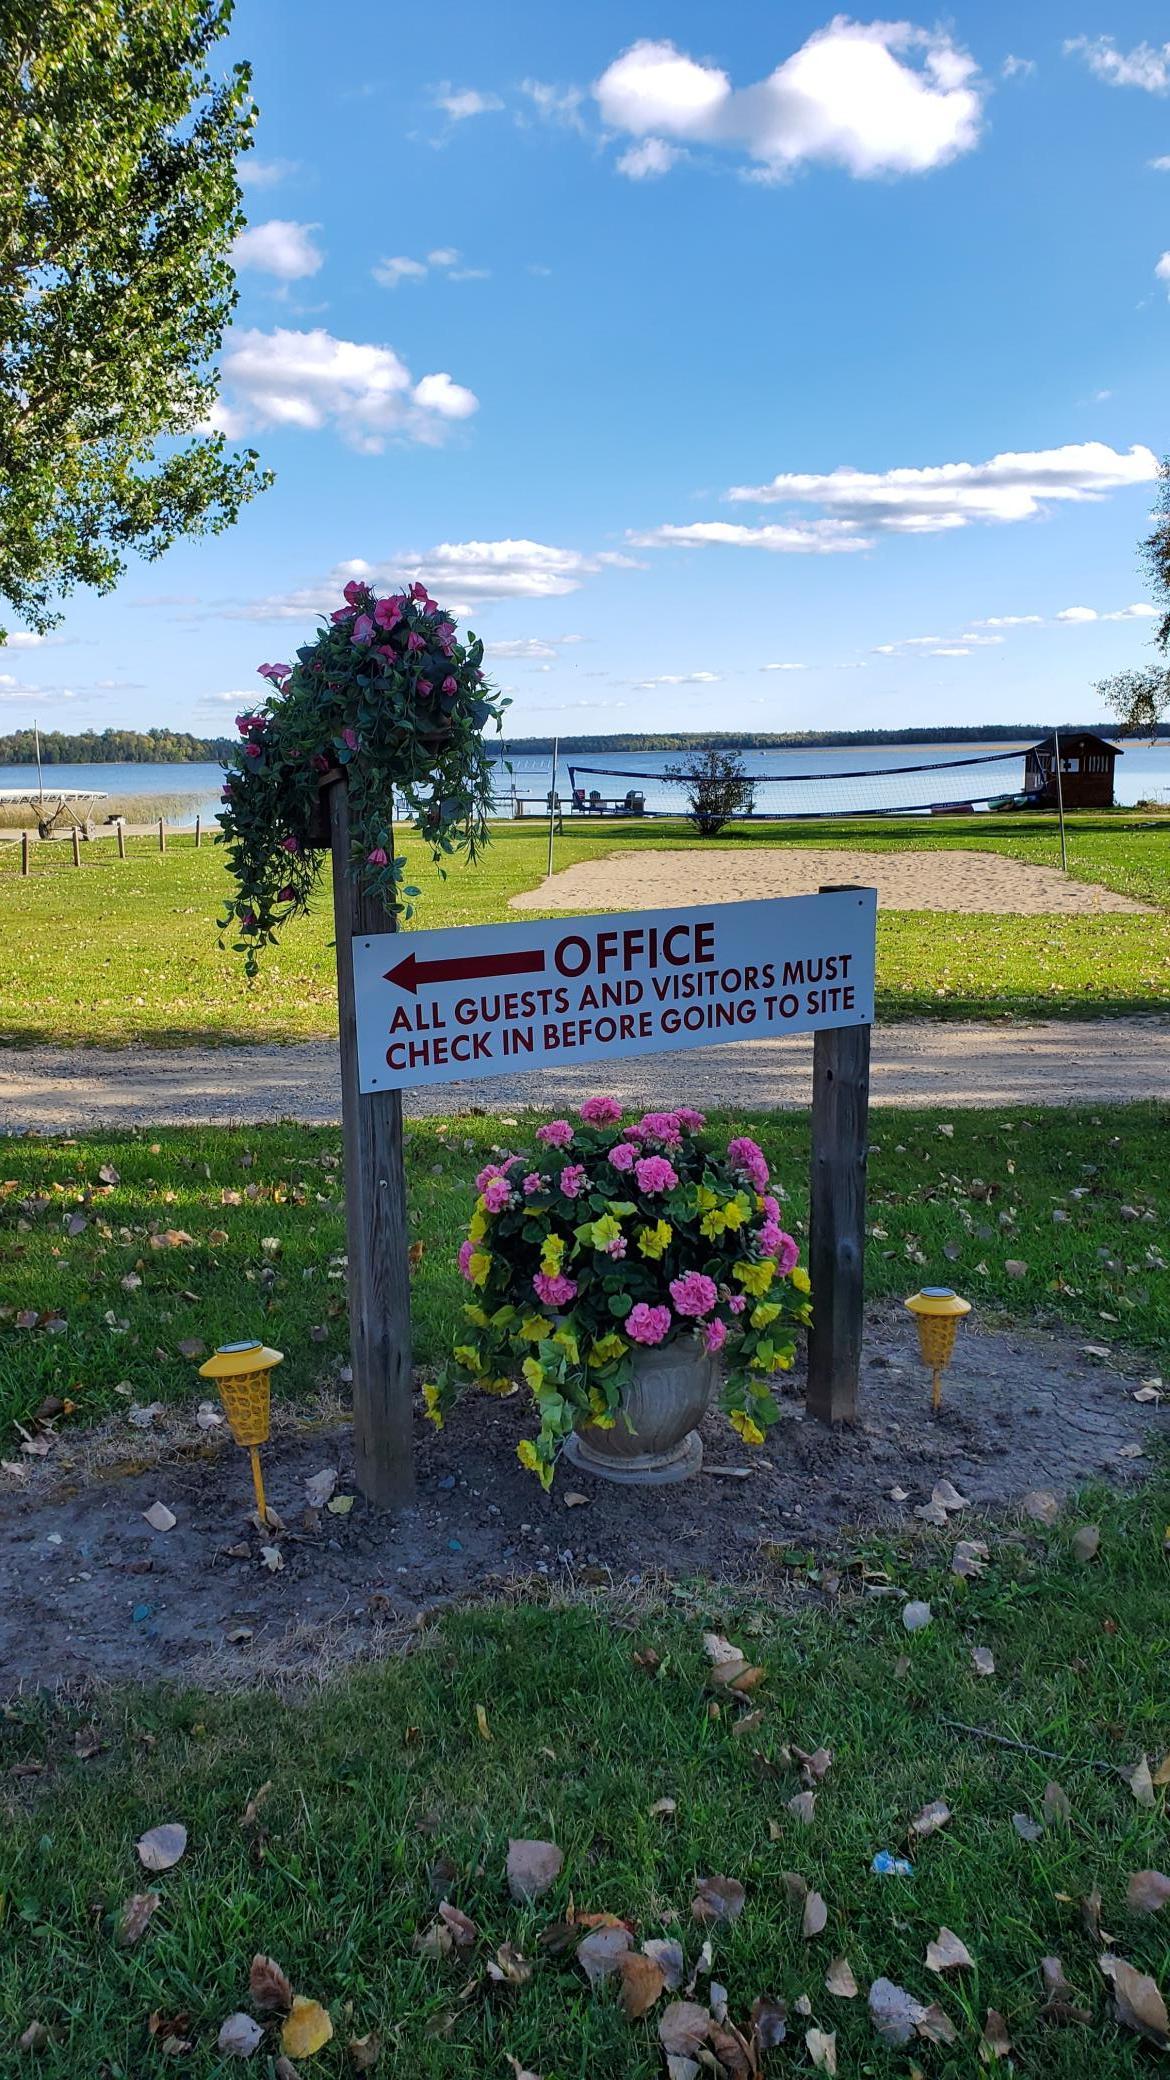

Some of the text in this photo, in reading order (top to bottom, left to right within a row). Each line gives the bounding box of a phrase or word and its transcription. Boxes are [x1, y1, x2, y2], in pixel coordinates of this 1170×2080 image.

[554, 922, 715, 978] OFFICE
[385, 986, 855, 1070] CHECK IN BEFORE GOING TO SITE
[389, 954, 853, 1034] ALL GUESTS AND VISITORS MUST
